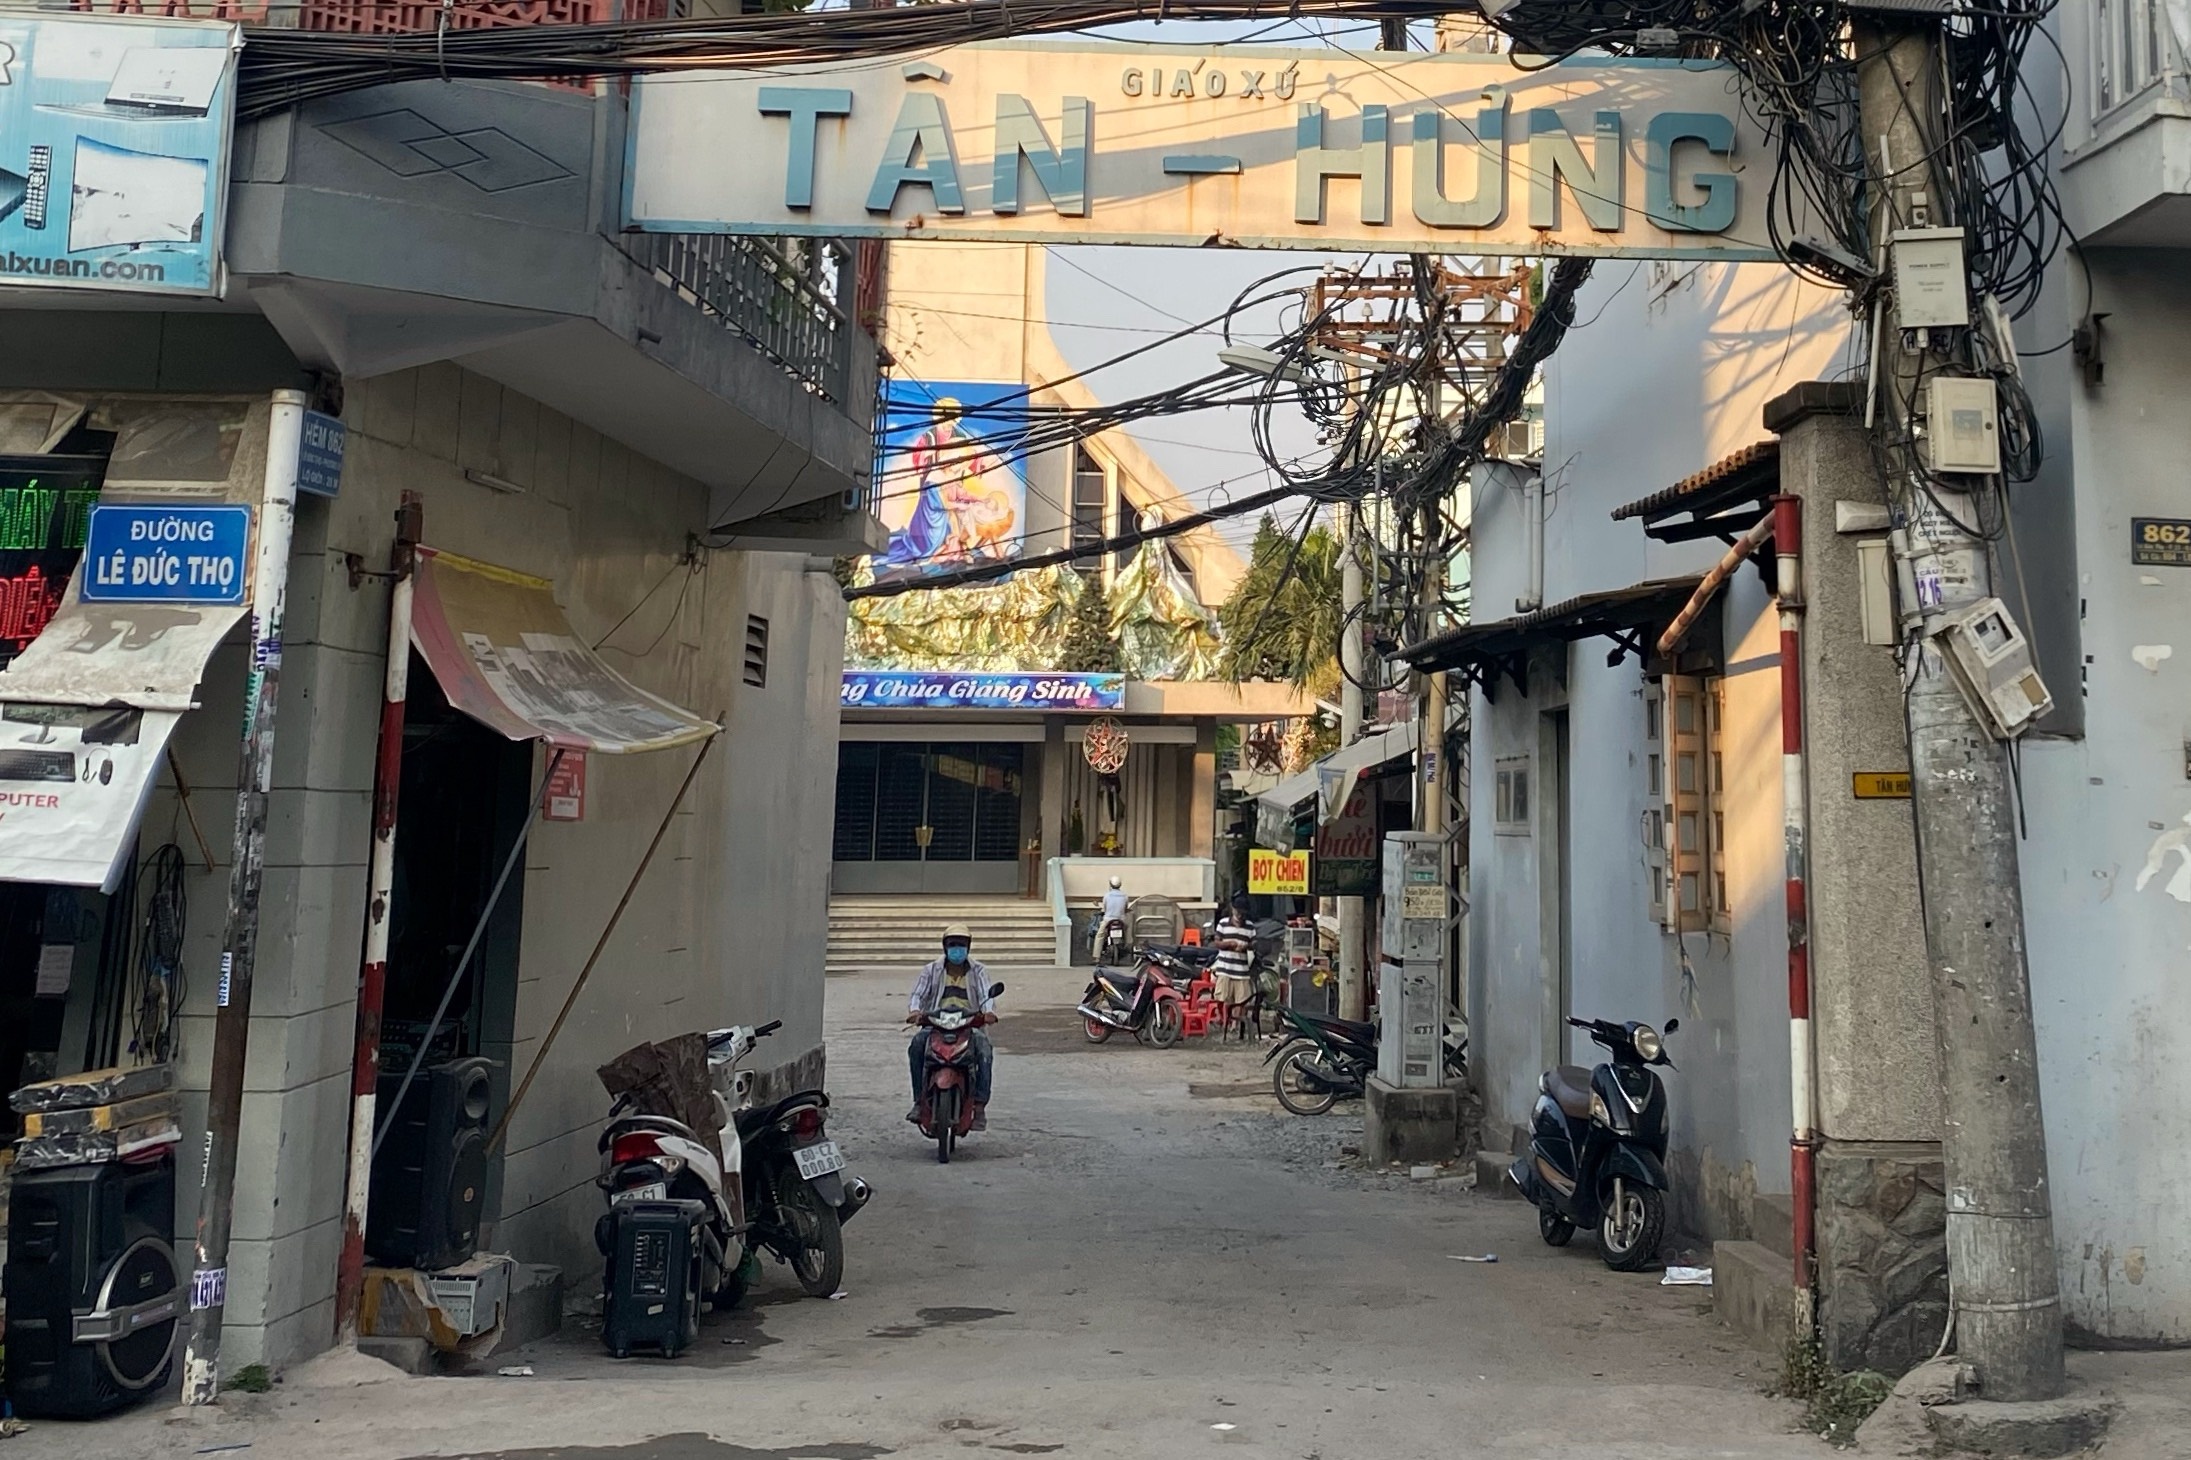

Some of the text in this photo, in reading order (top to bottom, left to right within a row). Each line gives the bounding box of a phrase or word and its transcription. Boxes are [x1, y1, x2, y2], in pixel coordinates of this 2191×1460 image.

[1121, 58, 1299, 100] GIÁO XỨ
[758, 61, 1088, 218] TÂN
[1294, 84, 1738, 232] HƯNG
[62, 480, 101, 549] TÍ
[131, 516, 214, 541] ĐƯỜNG
[2143, 524, 2190, 544] 862
[97, 547, 235, 595] LÊ ĐỨC THỌ
[873, 678, 942, 699] Chúa
[949, 678, 1025, 702] Giáng
[1031, 679, 1092, 700] Sinh
